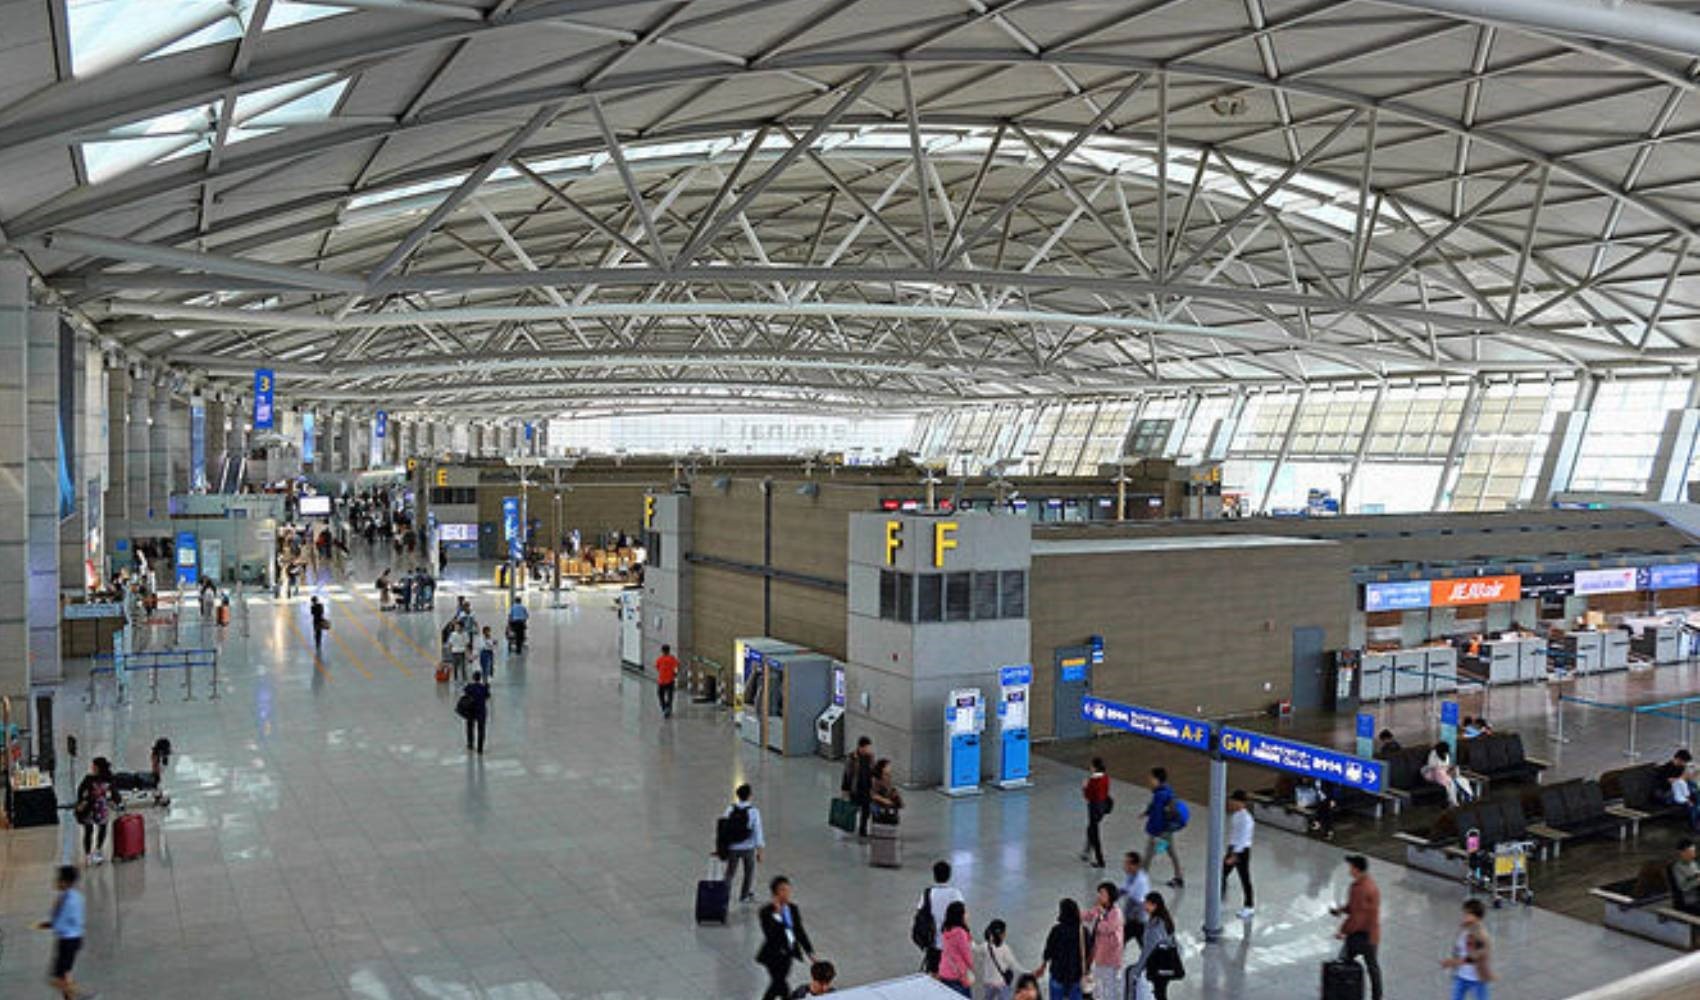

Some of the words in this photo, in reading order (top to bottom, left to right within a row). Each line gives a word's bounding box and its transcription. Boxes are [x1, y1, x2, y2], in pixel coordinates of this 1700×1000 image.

[260, 376, 271, 392] 3
[436, 467, 449, 487] E
[644, 496, 656, 529] F
[886, 520, 904, 567] F
[934, 522, 958, 568] F
[1181, 724, 1204, 743] A-F
[1222, 733, 1251, 755] G-M
